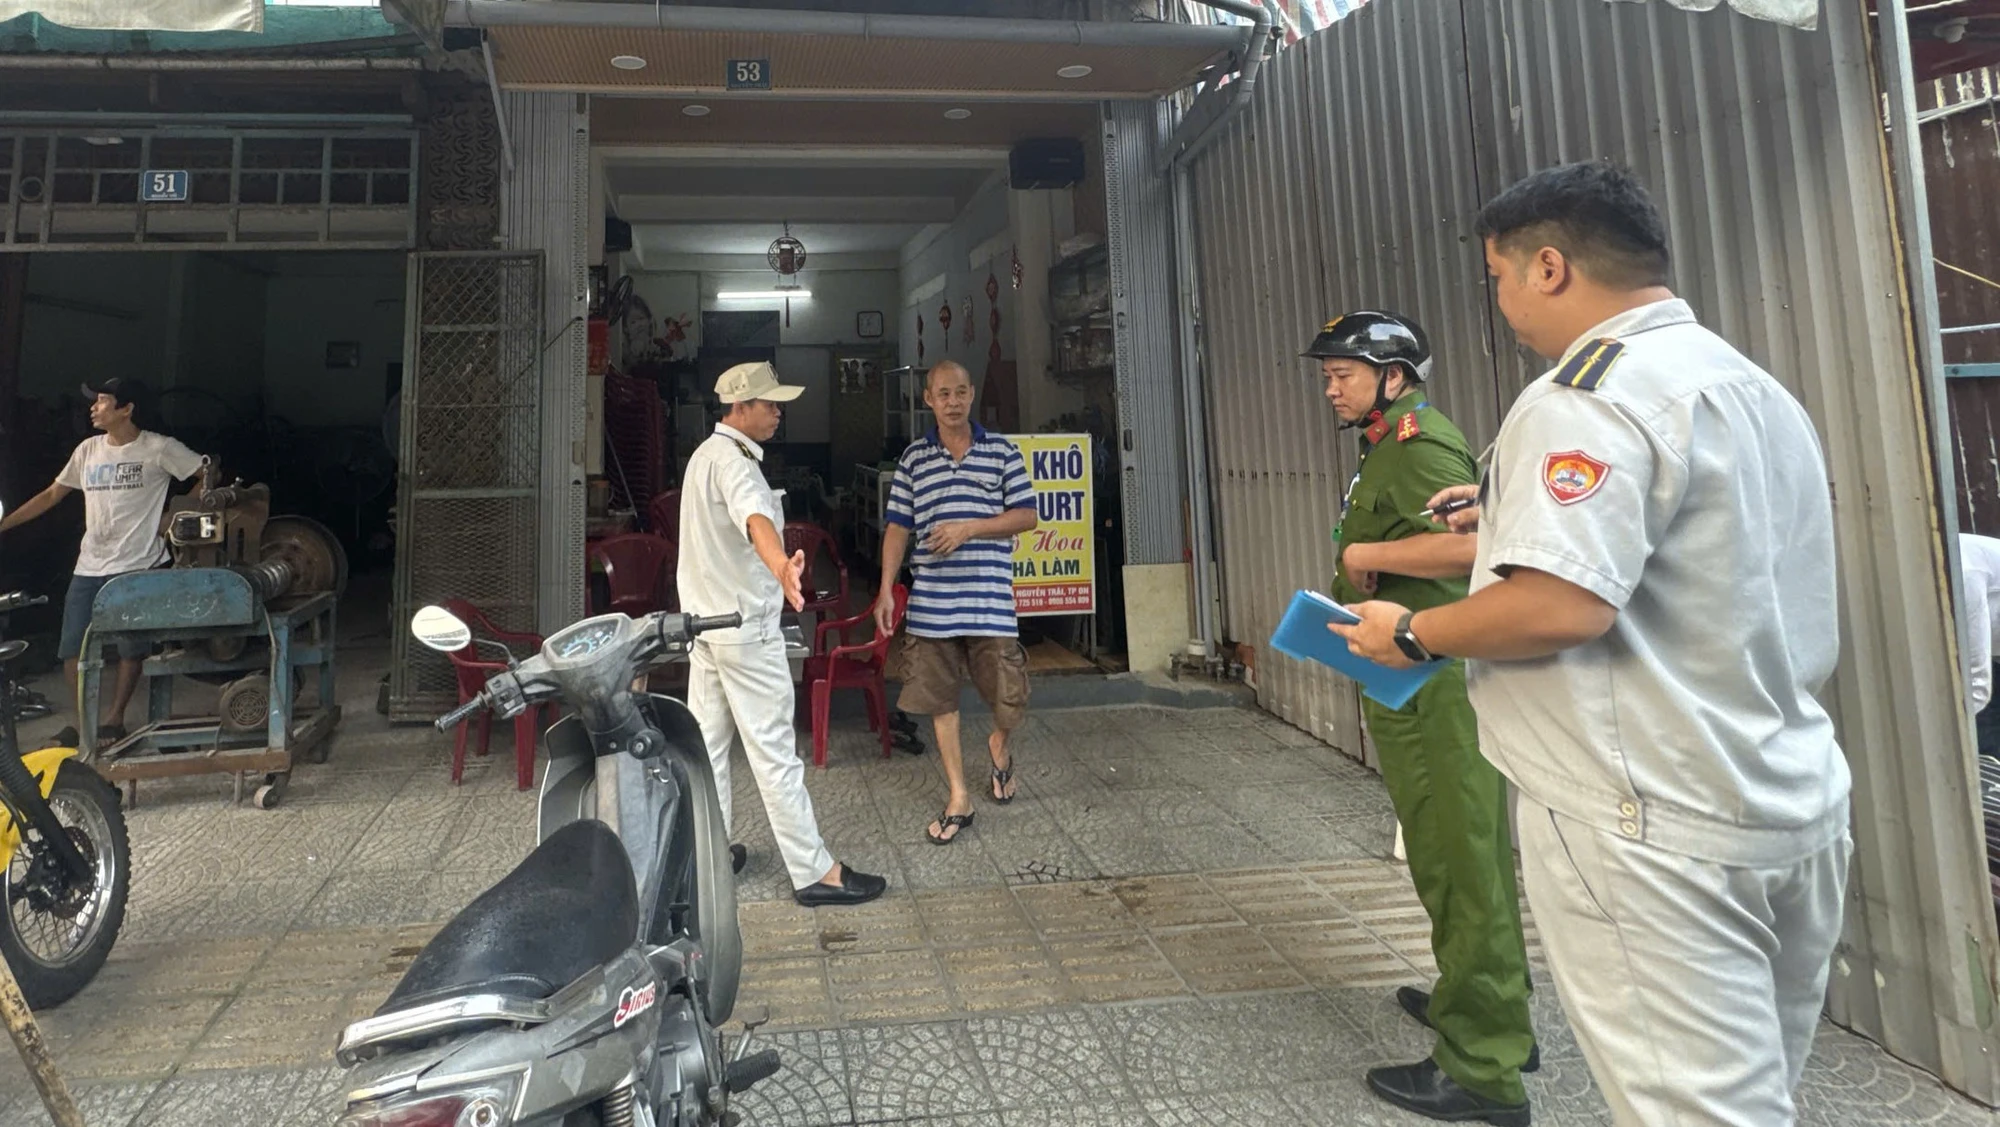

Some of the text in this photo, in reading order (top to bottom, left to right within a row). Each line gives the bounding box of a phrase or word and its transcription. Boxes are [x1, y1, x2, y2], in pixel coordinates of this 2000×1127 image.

[737, 62, 760, 81] 53
[154, 174, 174, 192] 51
[1033, 444, 1083, 480] KHÔ
[1038, 491, 1085, 521] URT
[1032, 529, 1084, 552] Hoa
[1012, 556, 1080, 577] HÀ LÀM
[615, 981, 656, 1027] SIRIUS
